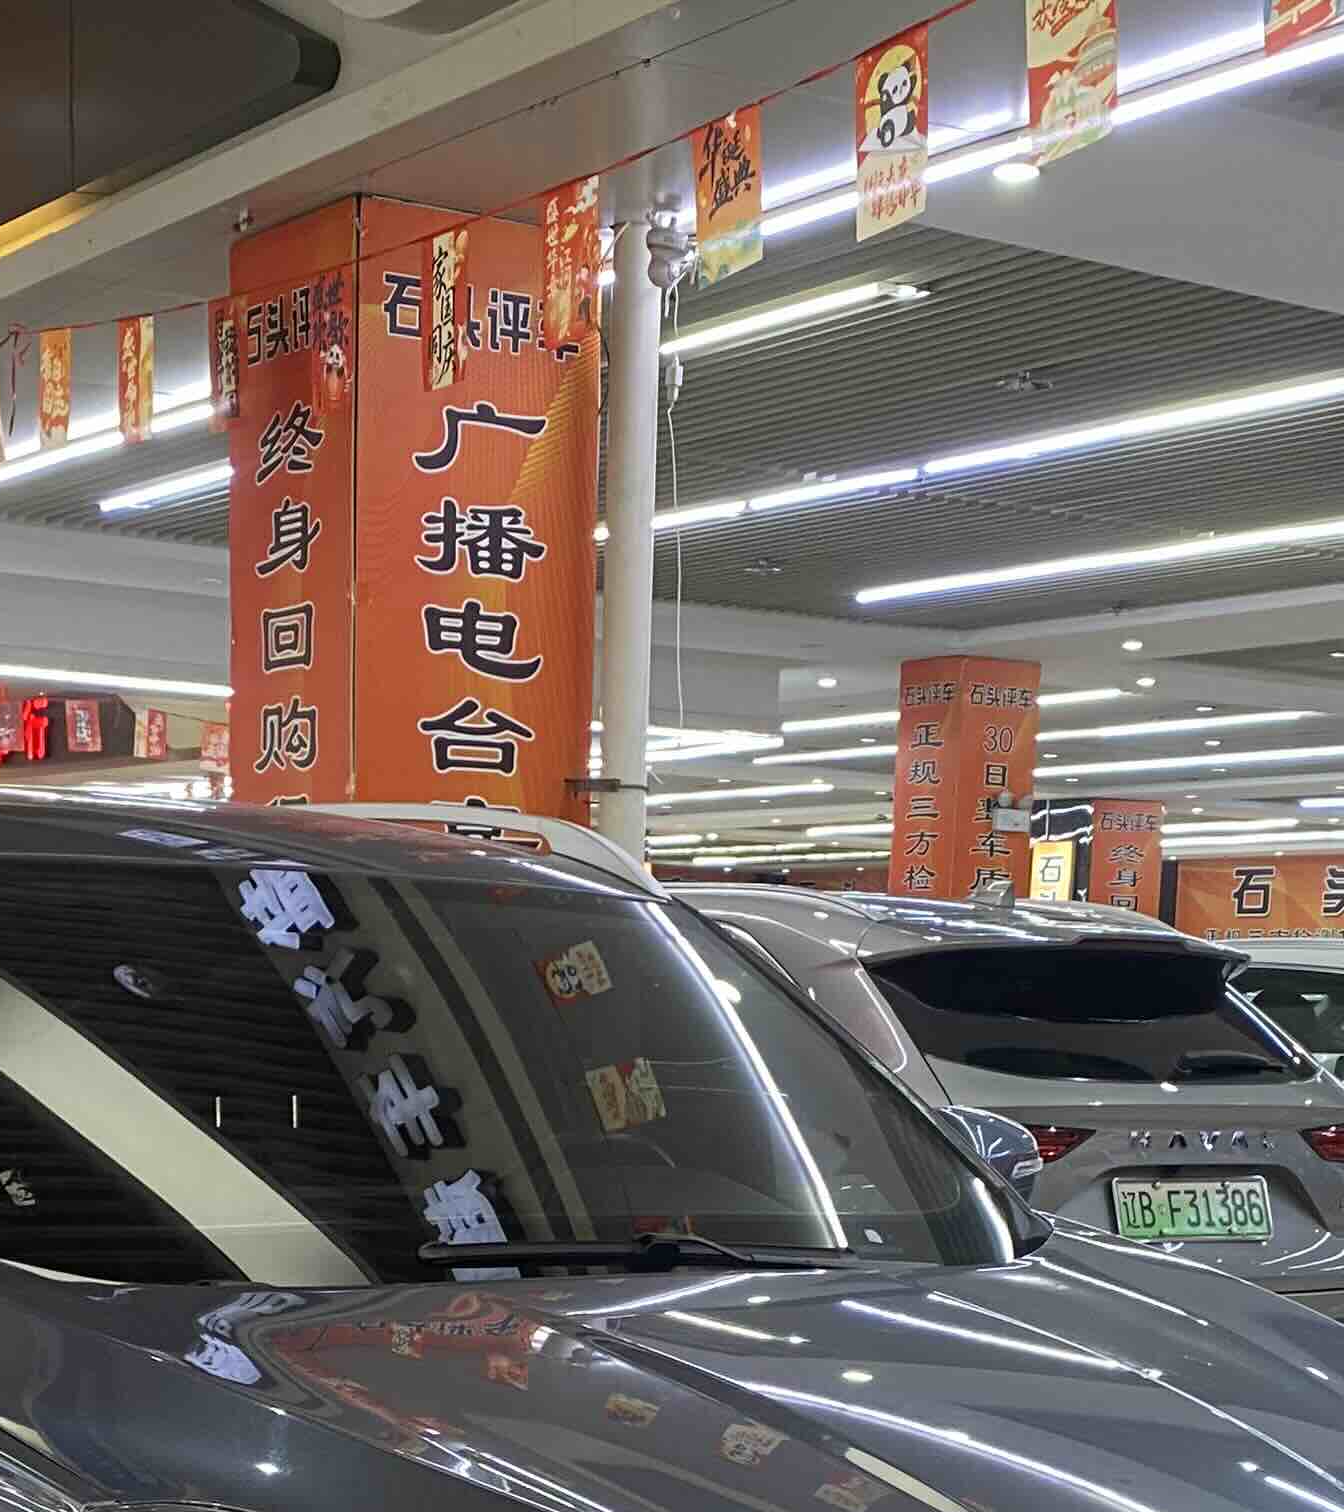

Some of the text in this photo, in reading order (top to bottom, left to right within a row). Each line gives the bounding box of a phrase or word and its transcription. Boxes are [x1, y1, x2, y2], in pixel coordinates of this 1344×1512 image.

[255, 400, 325, 807] 终身回购
[414, 401, 548, 776] 广播电台
